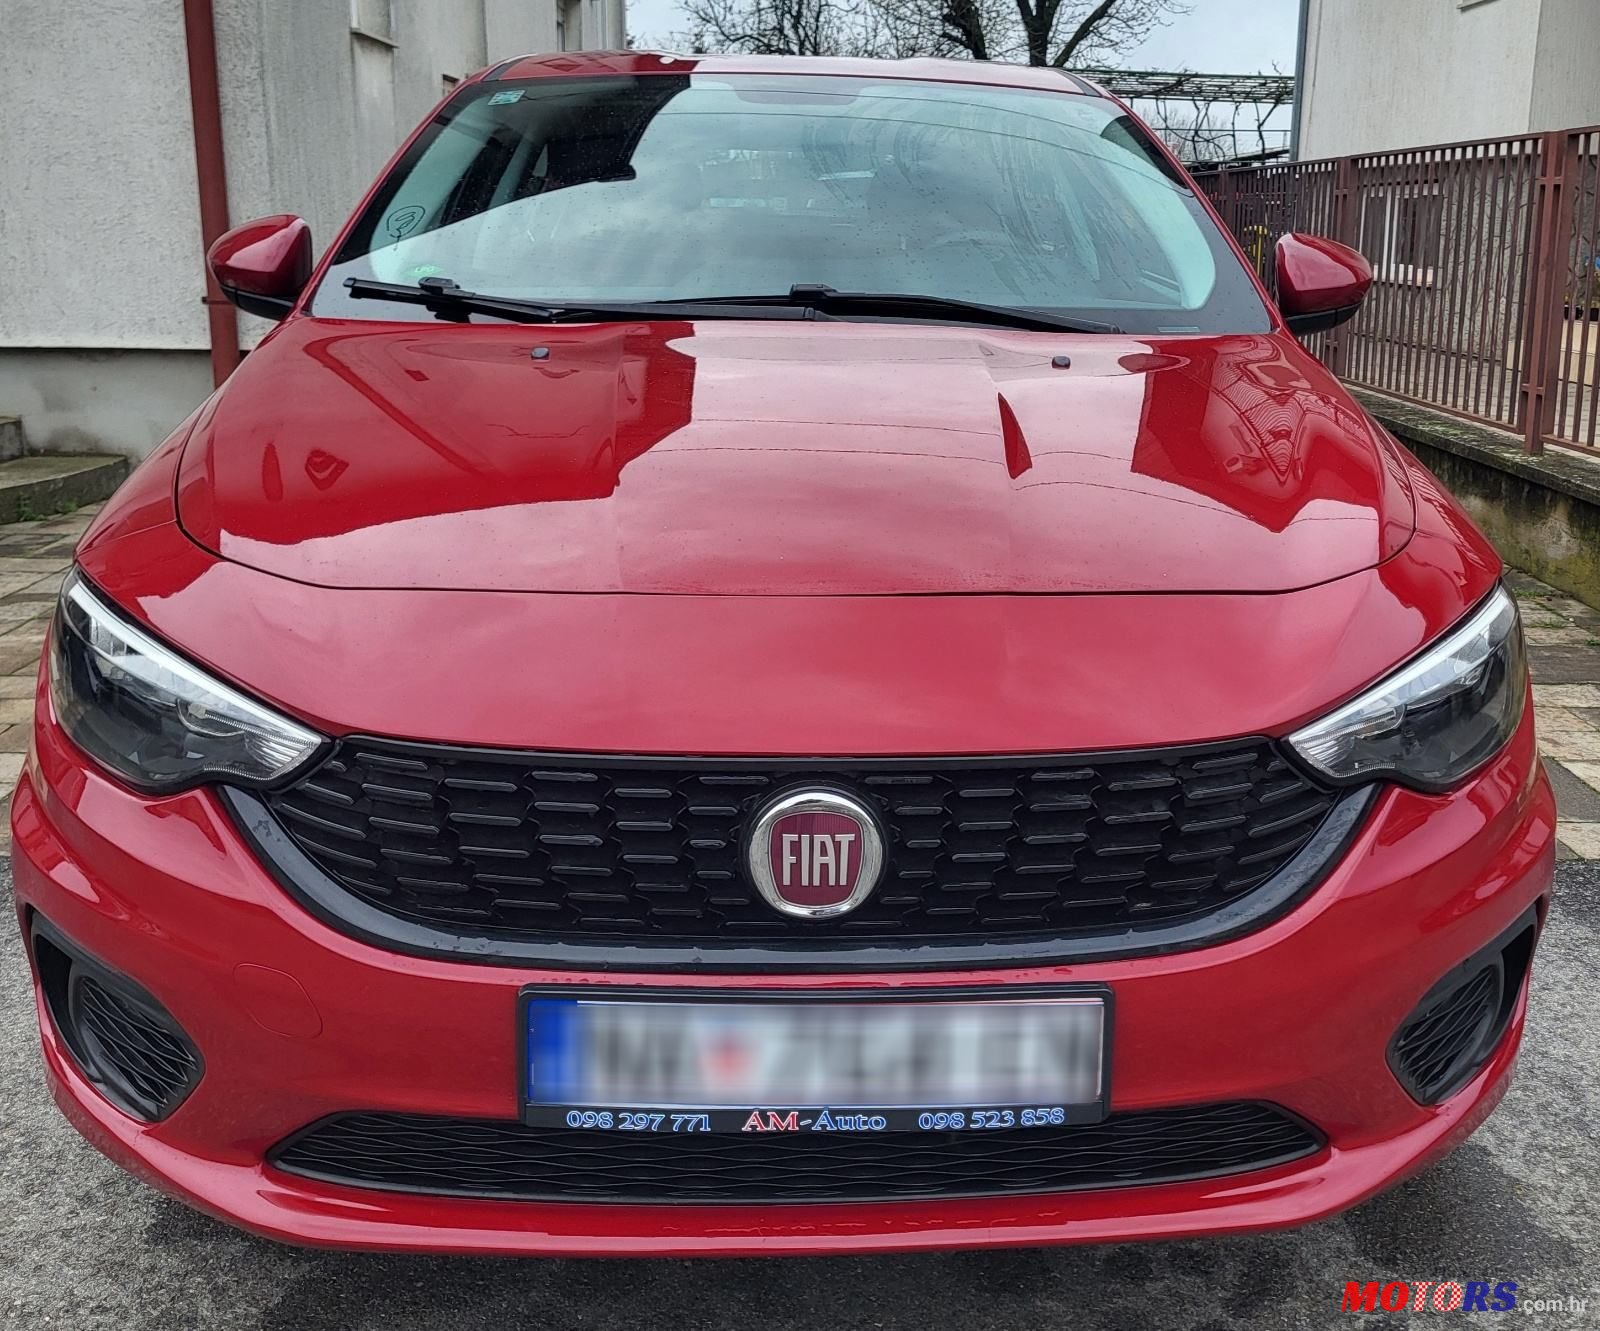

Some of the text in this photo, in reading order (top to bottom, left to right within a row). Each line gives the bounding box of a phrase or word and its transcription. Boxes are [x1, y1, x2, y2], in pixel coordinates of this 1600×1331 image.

[782, 833, 856, 887] FIAT
[566, 1107, 1065, 1132] 098 297 771 AM-Auto 098 523 858
